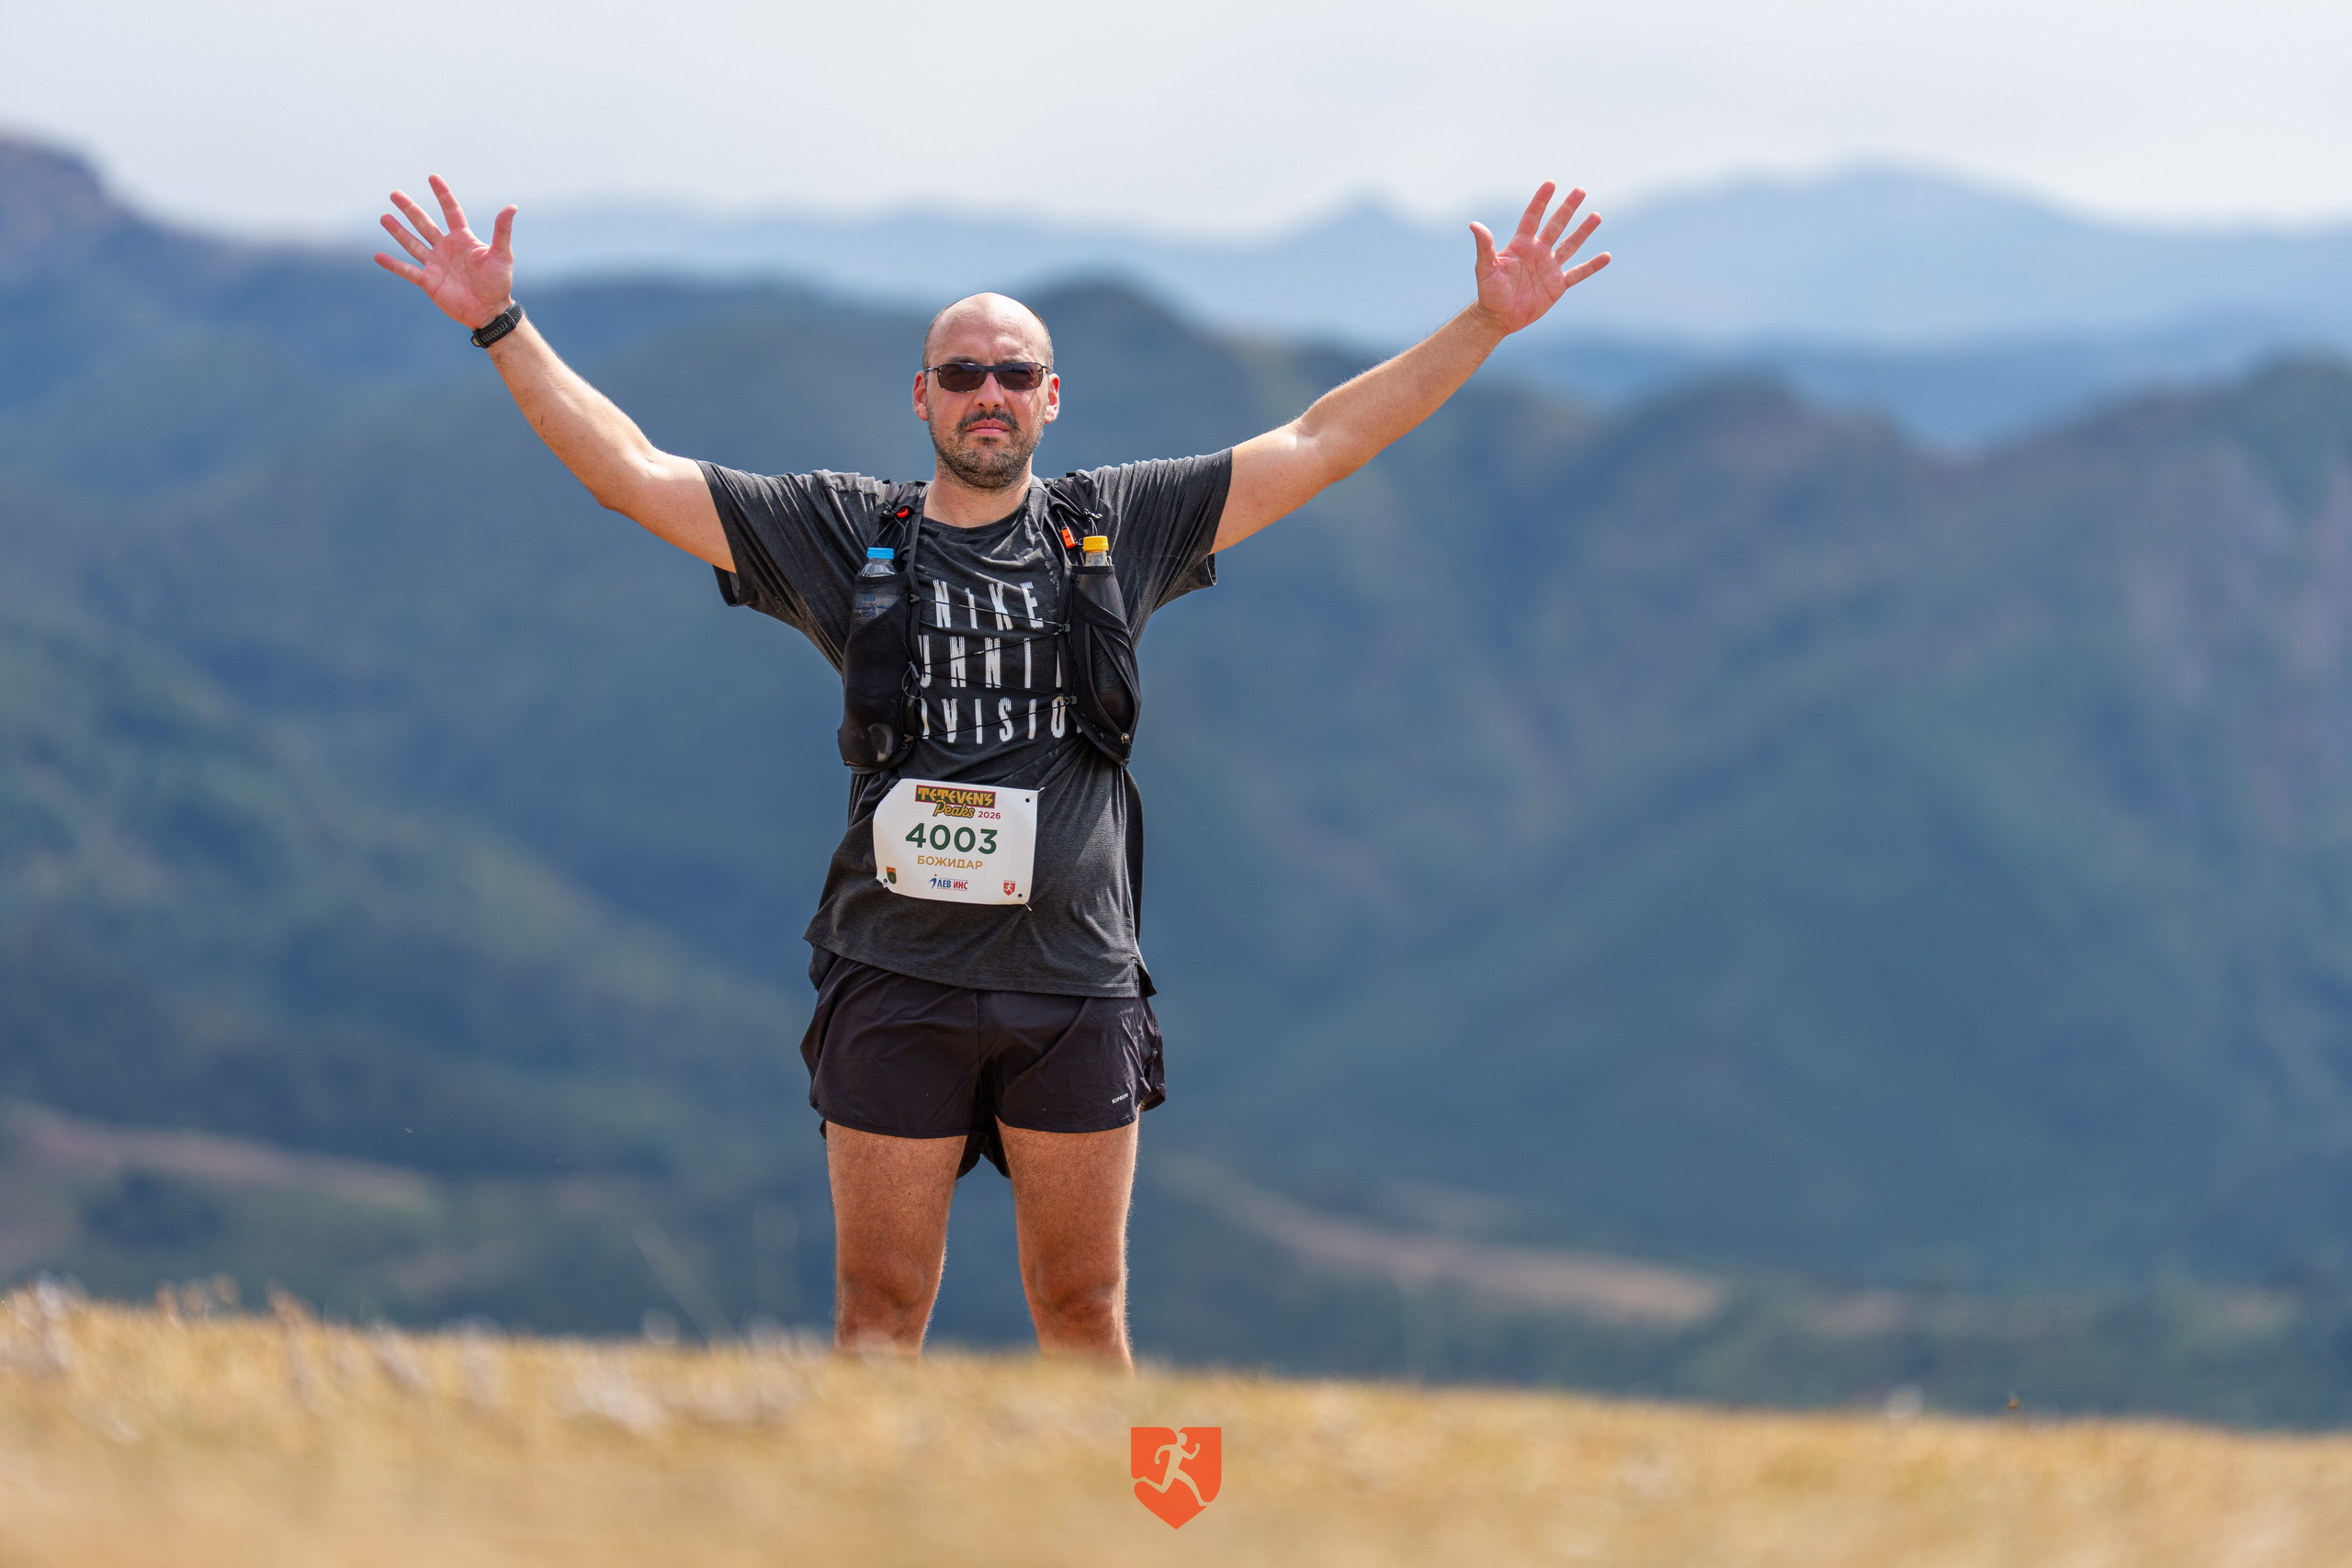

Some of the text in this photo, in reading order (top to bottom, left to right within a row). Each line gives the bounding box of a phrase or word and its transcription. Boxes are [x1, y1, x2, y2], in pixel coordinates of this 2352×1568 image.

[933, 579, 1044, 631] NIKE
[933, 799, 1001, 820] Peaks 2026
[905, 822, 998, 854] 4003
[917, 854, 983, 870] БОЖИДАР
[953, 880, 968, 890] ИНС
